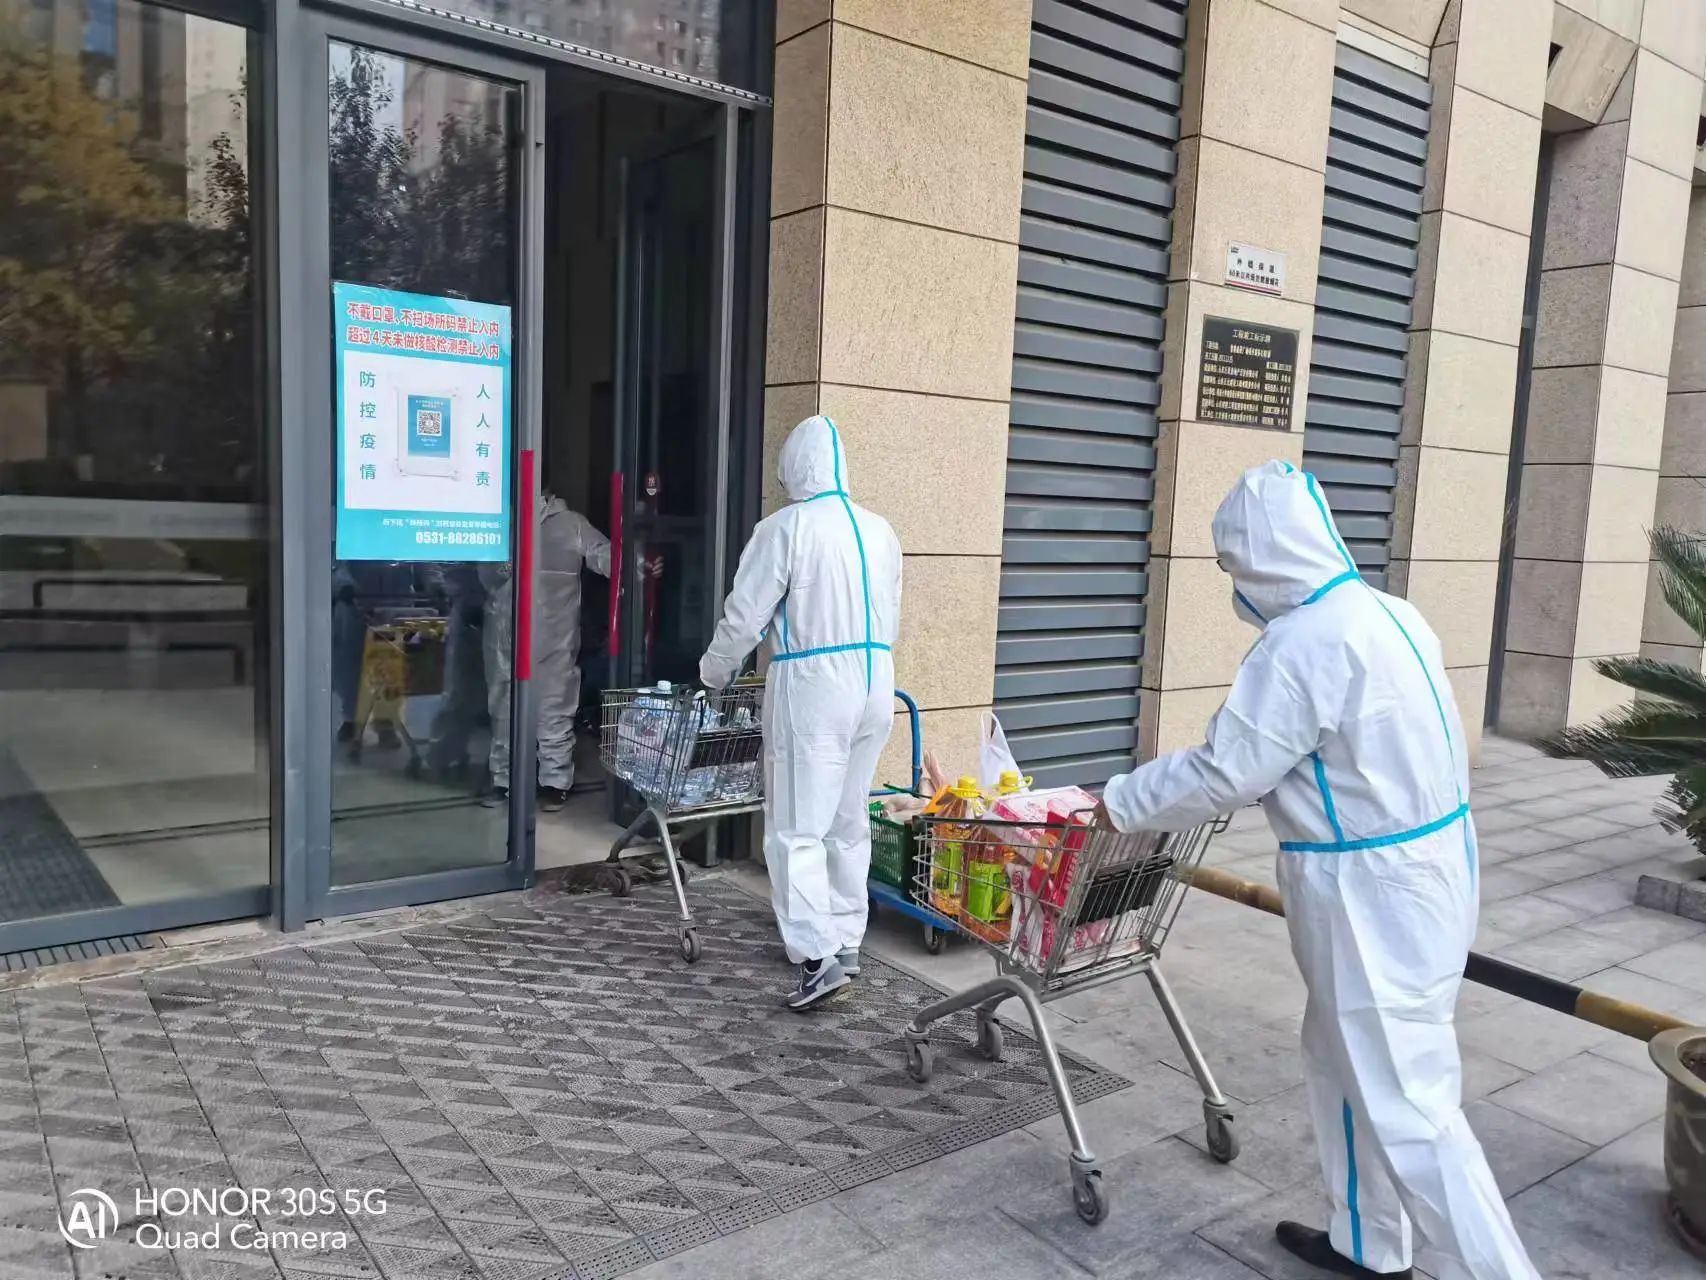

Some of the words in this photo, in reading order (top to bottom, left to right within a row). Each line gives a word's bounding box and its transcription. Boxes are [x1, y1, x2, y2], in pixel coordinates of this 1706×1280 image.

[359, 371, 377, 481] 防控疫情
[475, 383, 491, 487] 人人有责
